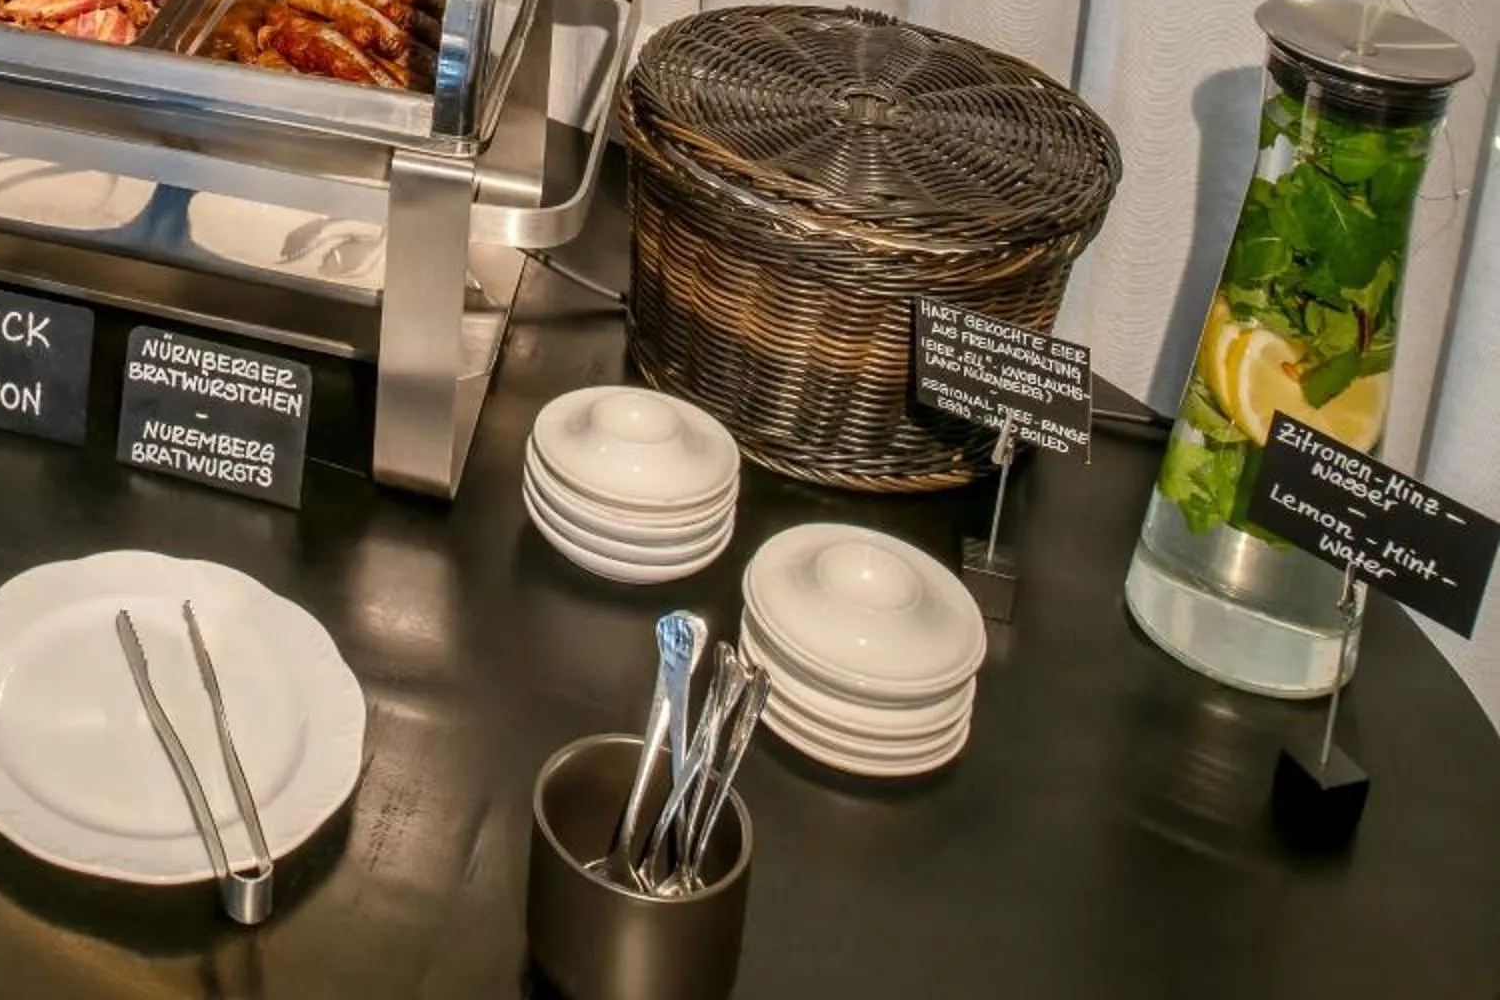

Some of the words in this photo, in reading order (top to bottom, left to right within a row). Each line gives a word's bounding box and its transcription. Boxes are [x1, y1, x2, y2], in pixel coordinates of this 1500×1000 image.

[921, 299, 962, 324] HART
[963, 313, 1047, 350] GEKOCHTE
[1051, 343, 1088, 366] EIER
[931, 321, 958, 340] AUS
[141, 333, 297, 389] NÜRNBERGER
[924, 351, 961, 372] LAND
[128, 362, 303, 418] BRATWÜRSTCHEN
[921, 377, 994, 411] REGIONAL
[142, 420, 276, 466] NUREMBERG
[1020, 427, 1069, 453] BOILED
[131, 442, 273, 488] BRATWURSTS
[1318, 534, 1397, 579] Water
